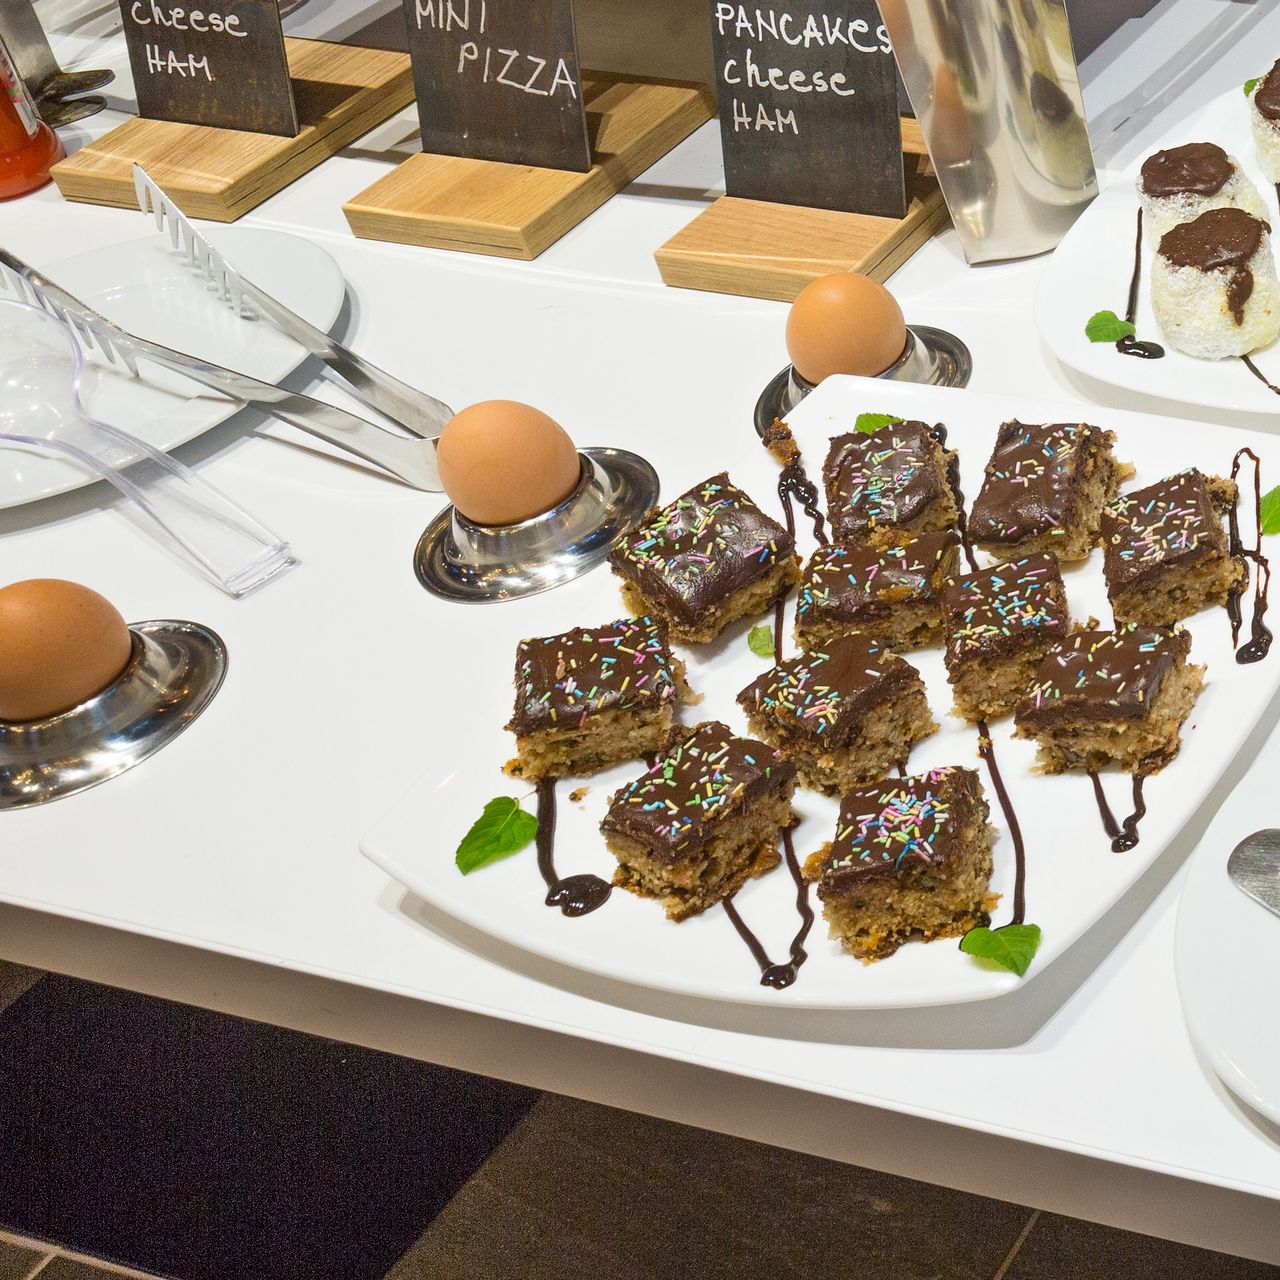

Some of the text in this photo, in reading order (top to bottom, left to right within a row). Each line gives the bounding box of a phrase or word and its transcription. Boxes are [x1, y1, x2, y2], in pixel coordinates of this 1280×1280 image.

[145, 43, 213, 82] HAM
[457, 41, 577, 99] PIZZA
[723, 48, 856, 97] cheese
[732, 98, 800, 135] HAM
